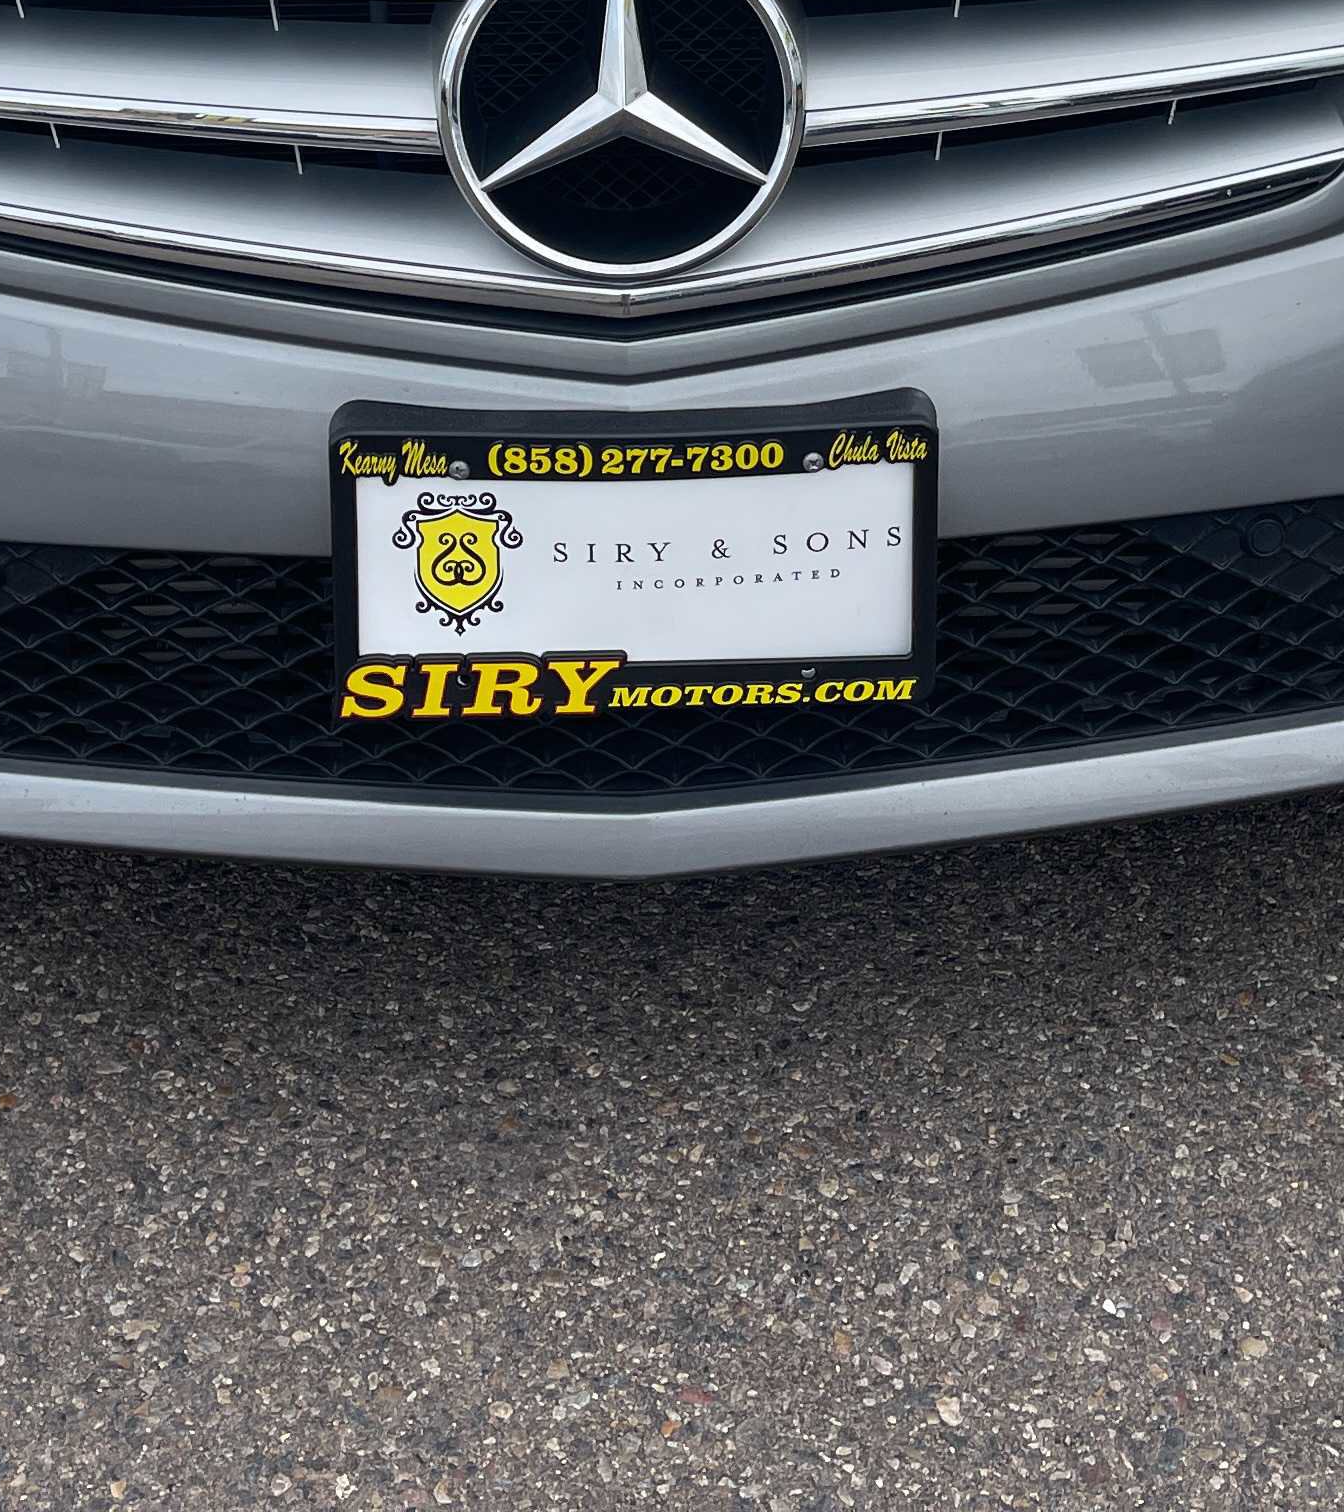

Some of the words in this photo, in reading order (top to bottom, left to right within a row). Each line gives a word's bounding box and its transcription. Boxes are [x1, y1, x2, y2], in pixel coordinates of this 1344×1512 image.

[339, 440, 397, 483] Kearny
[401, 440, 448, 476] Mesa
[487, 443, 594, 478] (858)
[601, 441, 785, 474] 277-7300
[827, 431, 880, 469] Chula
[885, 429, 929, 461] Vista
[552, 541, 672, 564] SIRY
[710, 538, 731, 560] &
[772, 525, 902, 556] SONS
[615, 567, 841, 591] INCORPORATED
